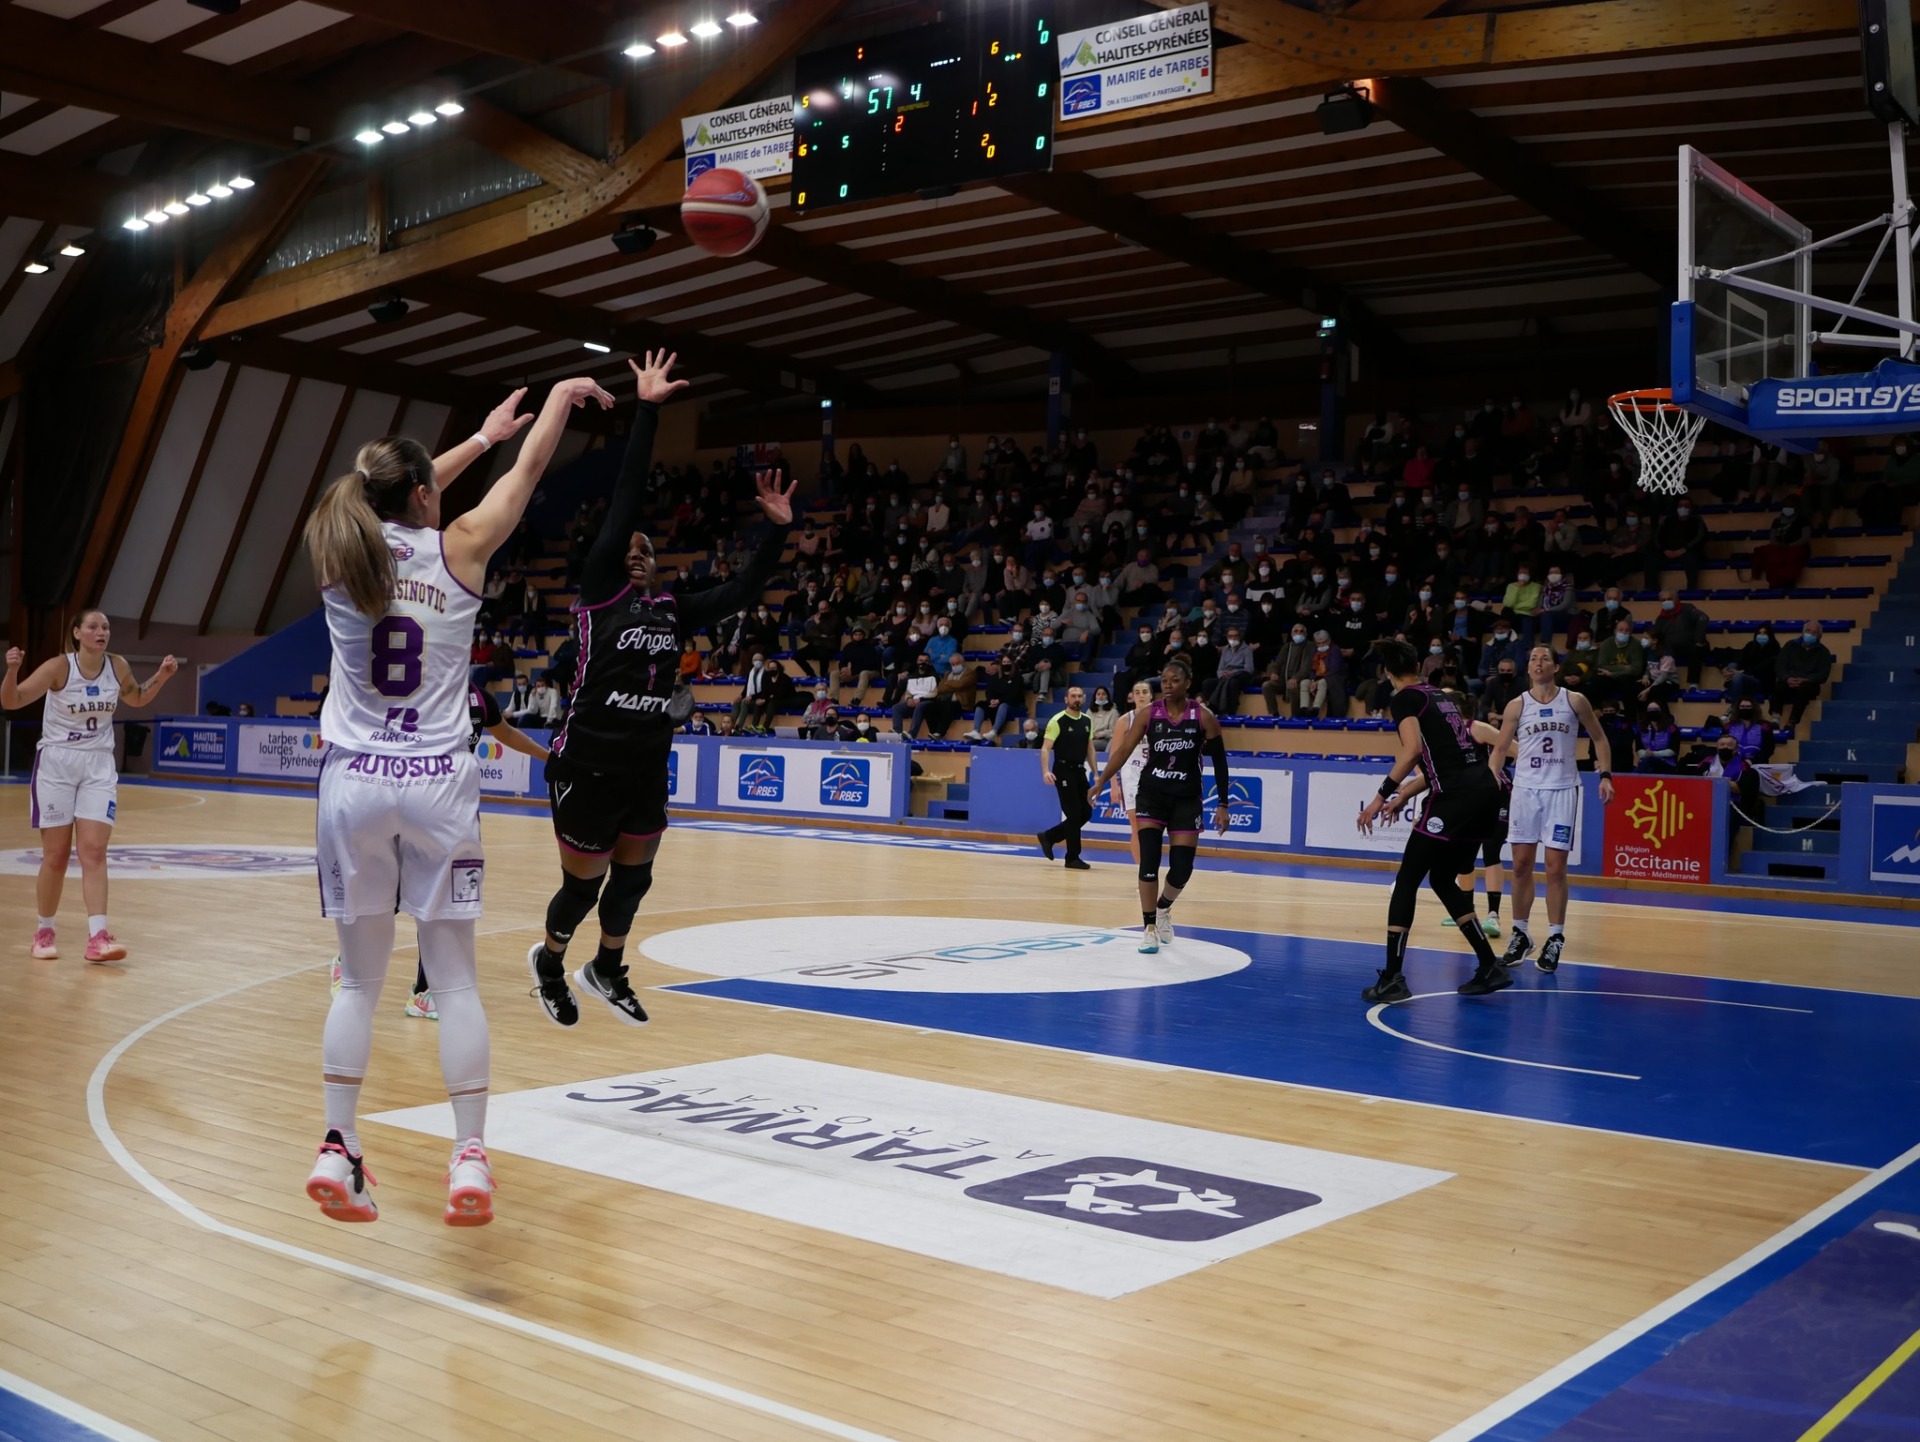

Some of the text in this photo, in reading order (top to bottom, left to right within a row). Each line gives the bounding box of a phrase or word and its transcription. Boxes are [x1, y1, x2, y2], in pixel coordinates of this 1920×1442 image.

[1096, 9, 1209, 45] CONSEIL GÉNÉRAL
[1097, 29, 1209, 64] HAUTES-PYRÉNÉES
[1106, 55, 1209, 87] MAIRIE de TARBES
[1121, 92, 1151, 104] TELLEMENT
[1157, 85, 1186, 97] PARTAGER
[709, 101, 793, 128] CONSEIL GÉNÉRAL
[711, 118, 794, 145] HAUTES-PYRÉNÉES
[719, 140, 793, 164] MAIRIE de TARBES
[390, 579, 447, 614] SINOVIC
[371, 614, 426, 698] 8
[648, 664, 657, 690] 1
[67, 701, 116, 714] TARBES
[605, 691, 671, 712] MARTY
[86, 716, 97, 731] 0
[1525, 721, 1570, 736] TARBES
[193, 731, 217, 741] HAUTES
[268, 730, 298, 745] tarbes
[369, 731, 423, 743] BARCOS
[259, 742, 294, 756] lourdes
[1154, 738, 1196, 753] Angers
[1542, 737, 1554, 753] 2
[1167, 756, 1176, 769] 2
[1847, 749, 1857, 761] K
[347, 752, 456, 779] AUTOSUR
[1152, 767, 1187, 780] MARTY
[747, 785, 779, 797] TARBES
[829, 789, 863, 802] TARBES
[1100, 806, 1129, 819] TARB
[1209, 812, 1253, 826] TBES
[1615, 844, 1650, 854] La Région
[1615, 852, 1700, 872] Occitanie
[1614, 867, 1646, 878] Pyrénées
[1652, 870, 1700, 880] Méditerranée
[564, 1084, 1000, 1180] TARMAC
